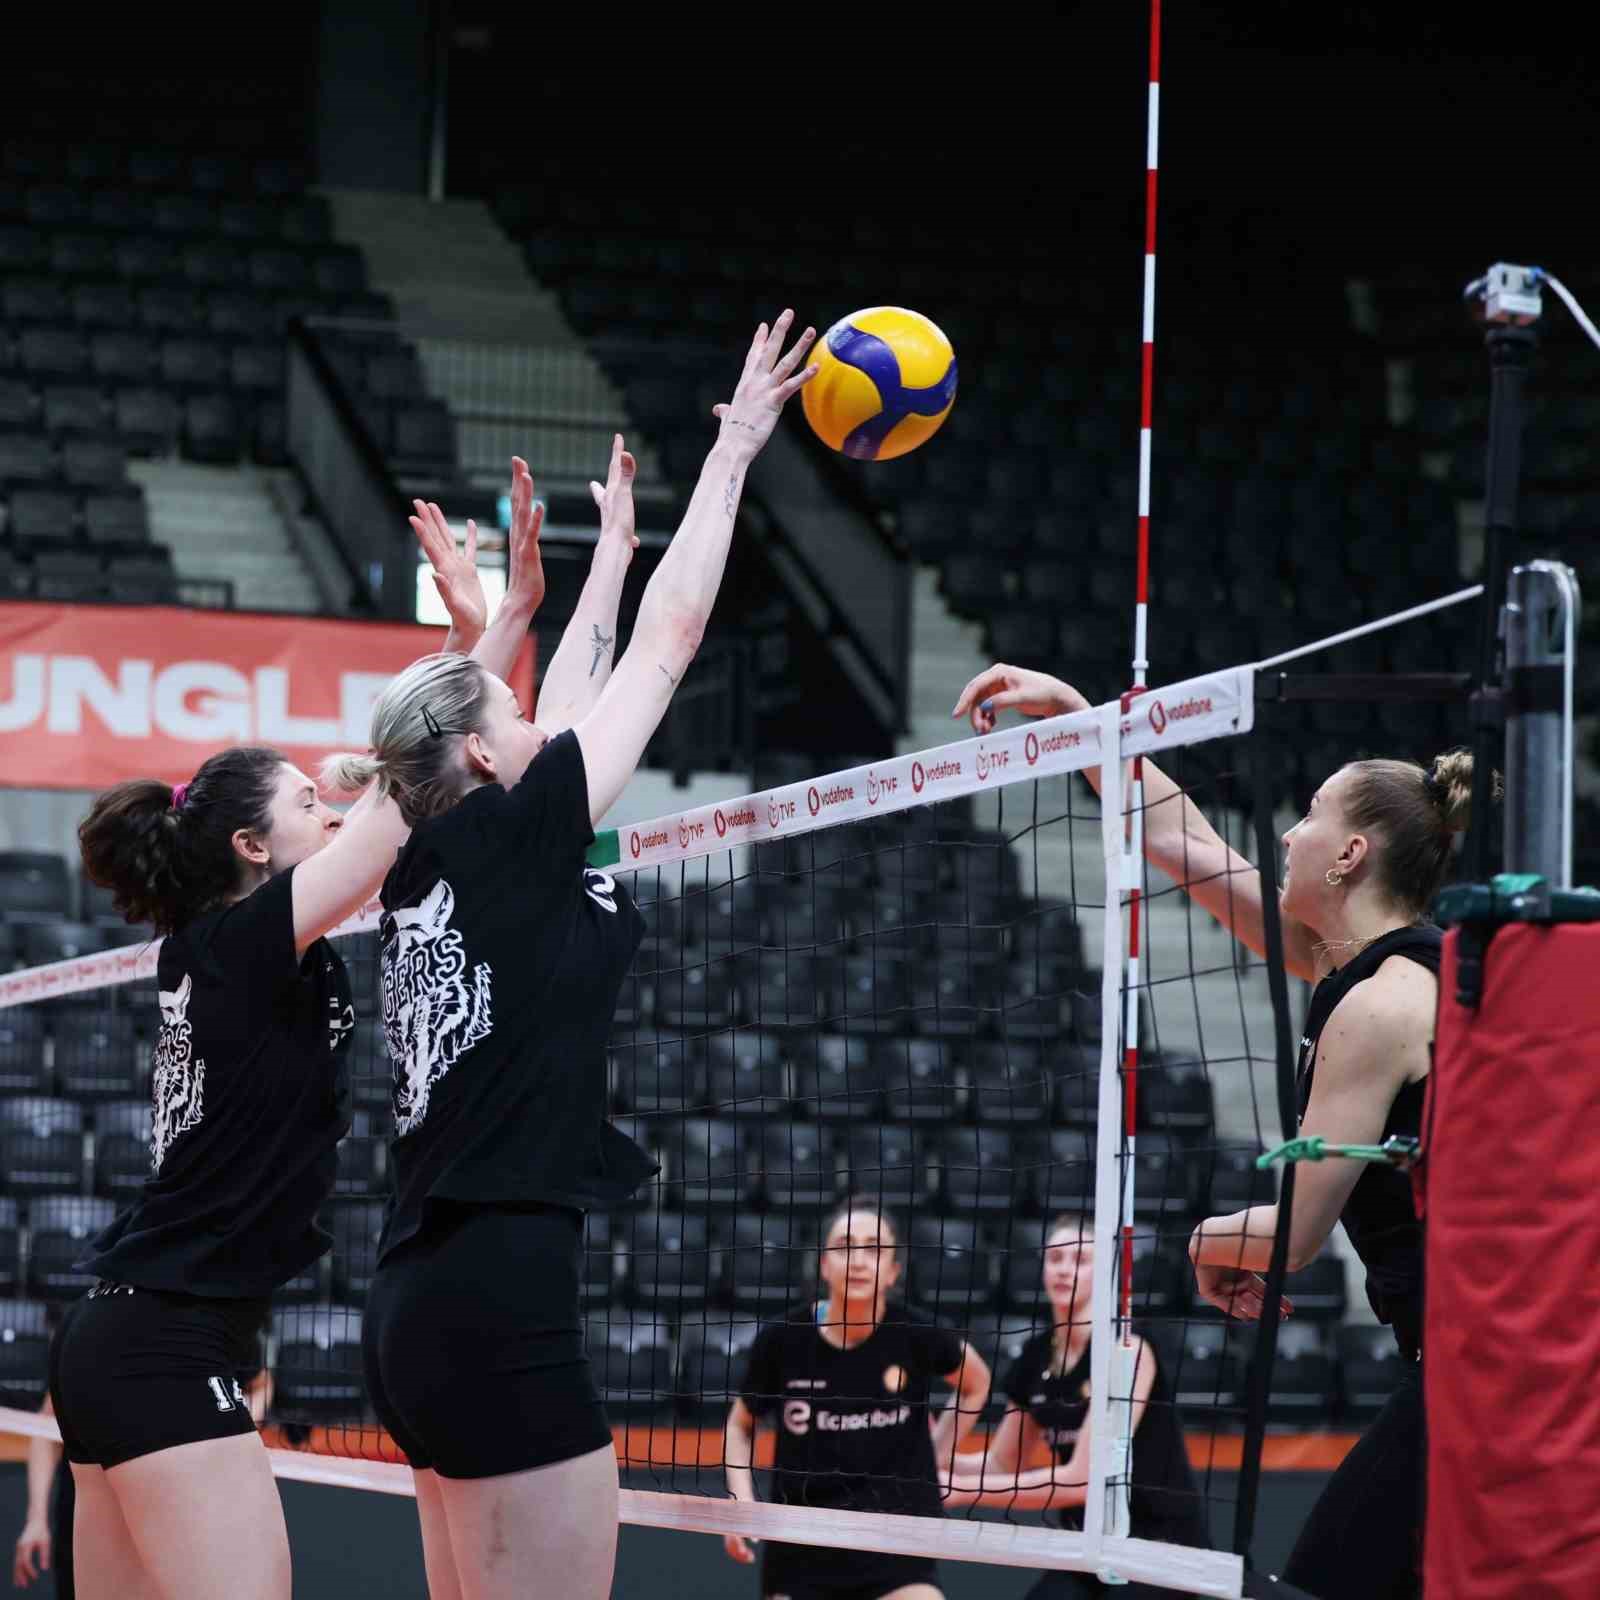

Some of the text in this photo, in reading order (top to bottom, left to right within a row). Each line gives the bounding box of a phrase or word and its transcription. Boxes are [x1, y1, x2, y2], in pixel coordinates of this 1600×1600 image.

[641, 697, 1213, 849] vodafone TVF vodafone TVF vodafone TVF vodafone TVF vodafone vodafone
